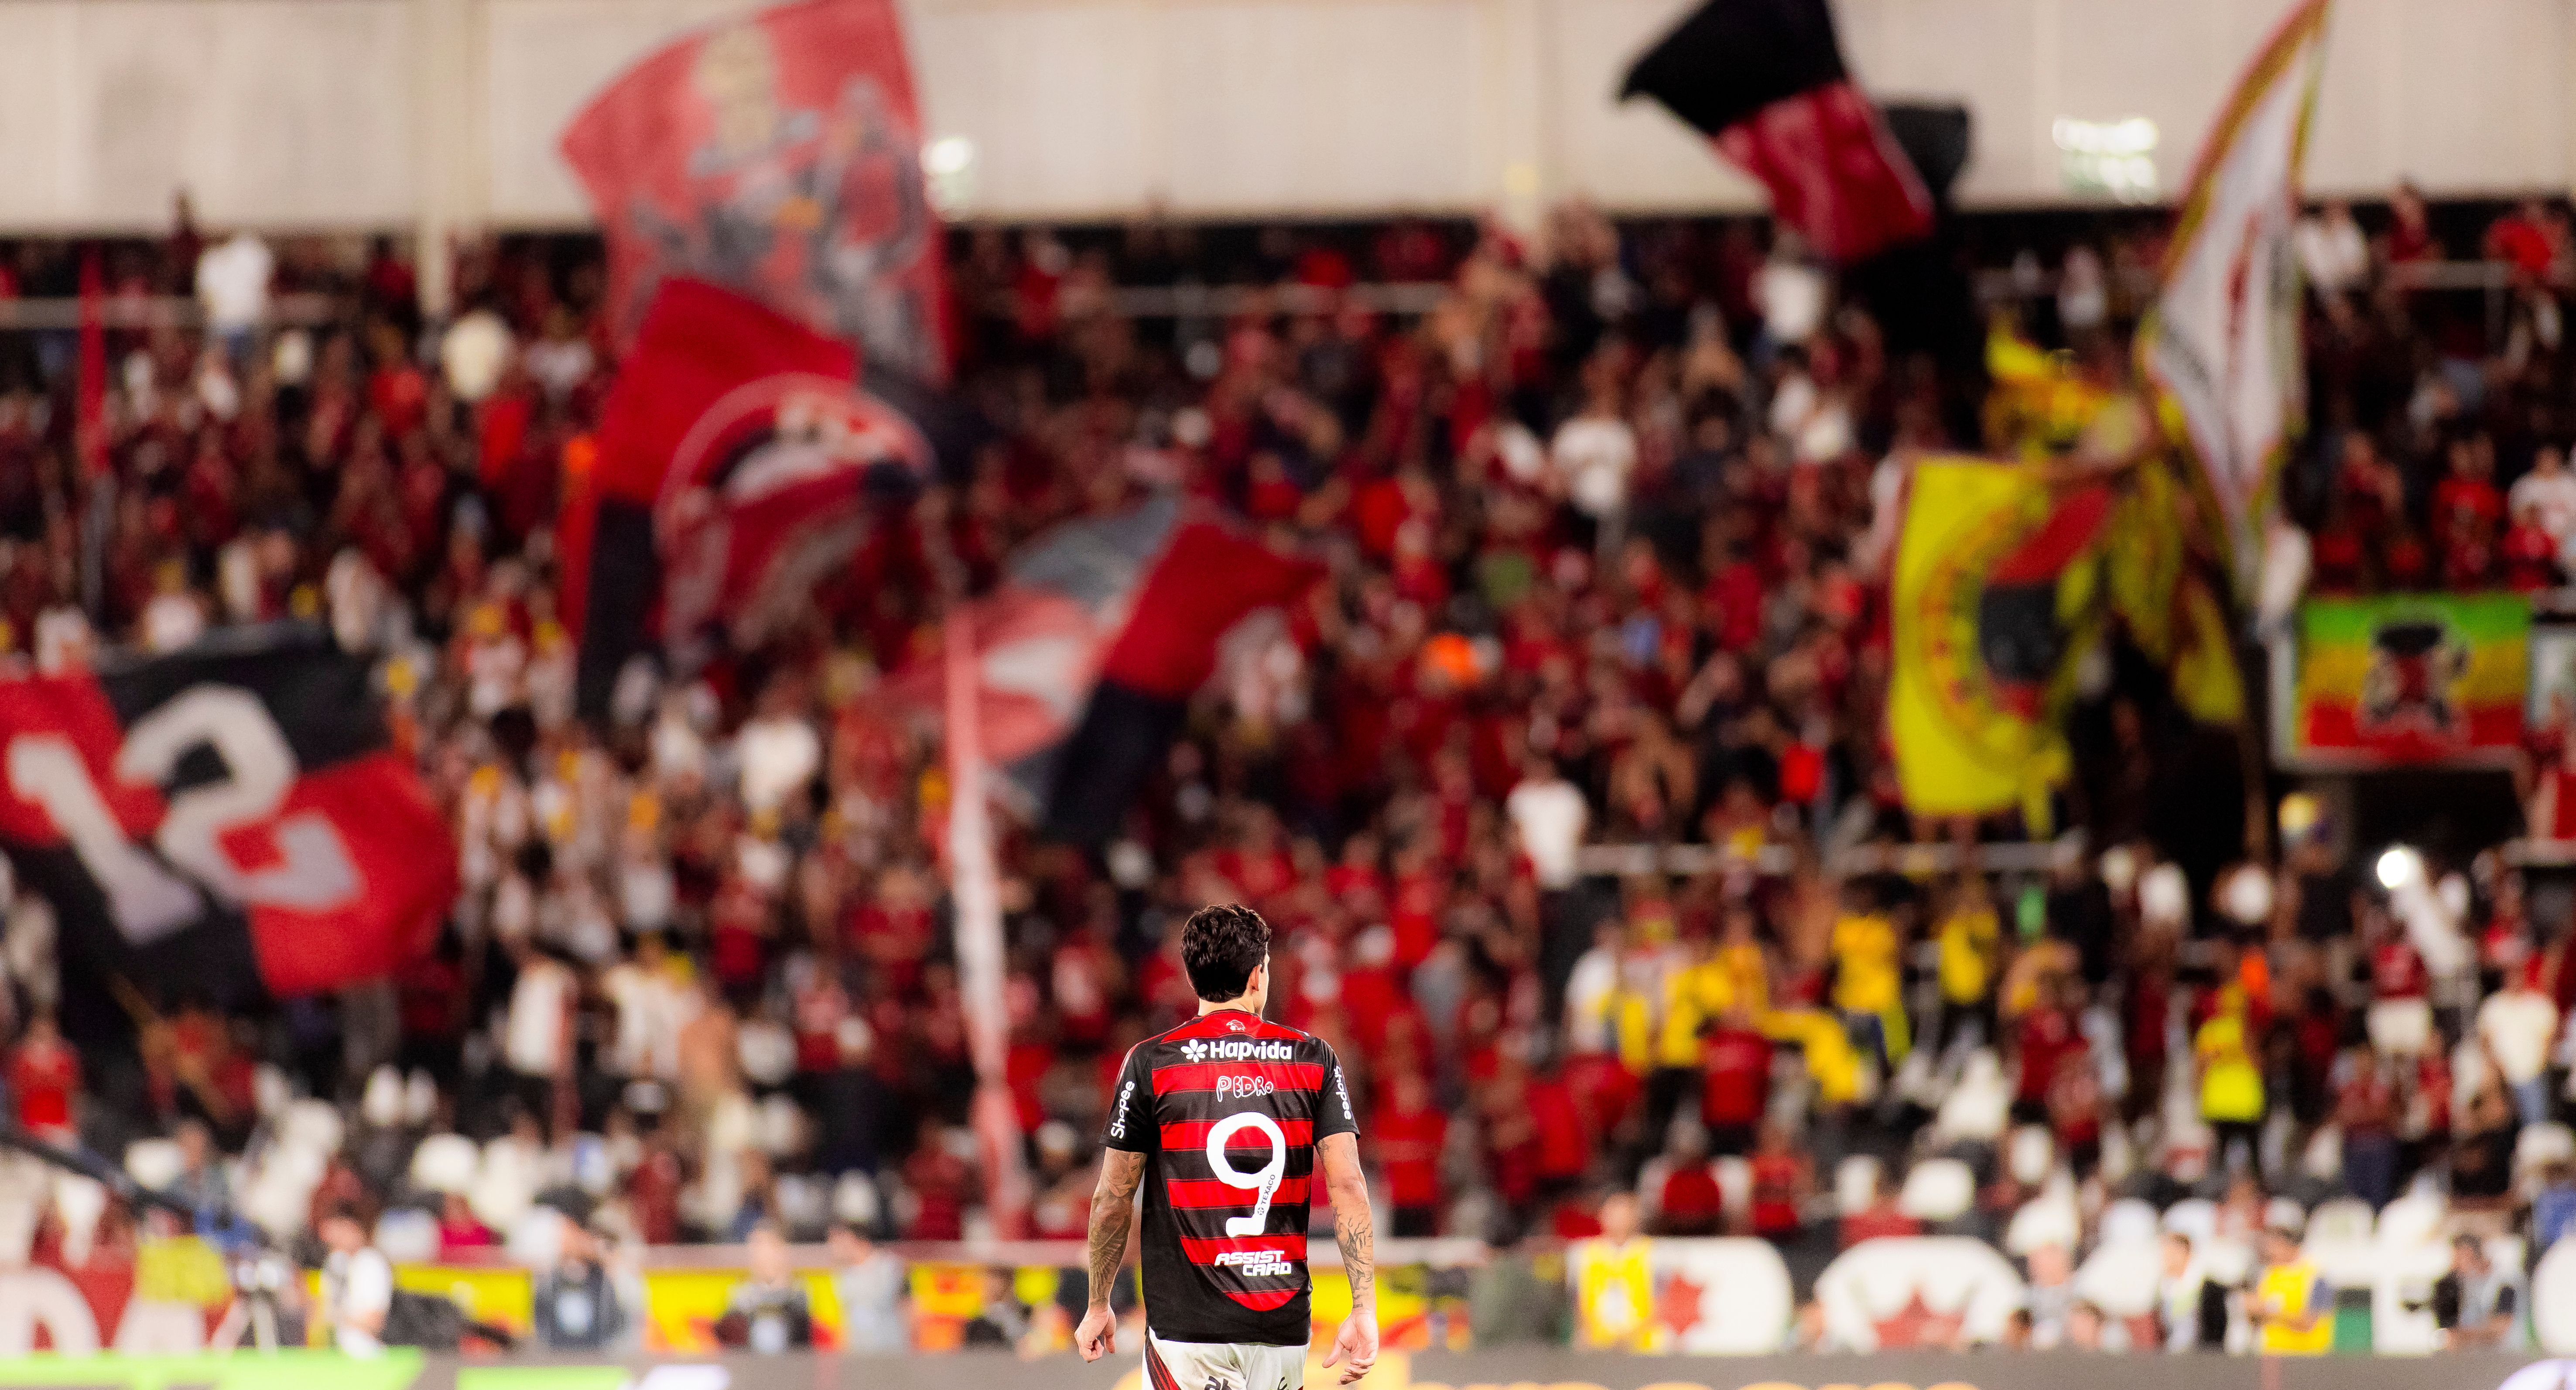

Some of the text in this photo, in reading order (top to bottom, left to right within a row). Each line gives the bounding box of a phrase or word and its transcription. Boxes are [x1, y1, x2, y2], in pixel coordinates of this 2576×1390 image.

[7, 682, 365, 944] 12
[1210, 1041, 1292, 1061] Hapvida
[1110, 1081, 1135, 1139] Shopee
[1334, 1065, 1352, 1120] Shopee
[1206, 1112, 1286, 1238] 9
[1261, 1174, 1276, 1205] TEXACO
[1214, 1250, 1285, 1266] ASSIST
[1242, 1262, 1292, 1276] CARD
